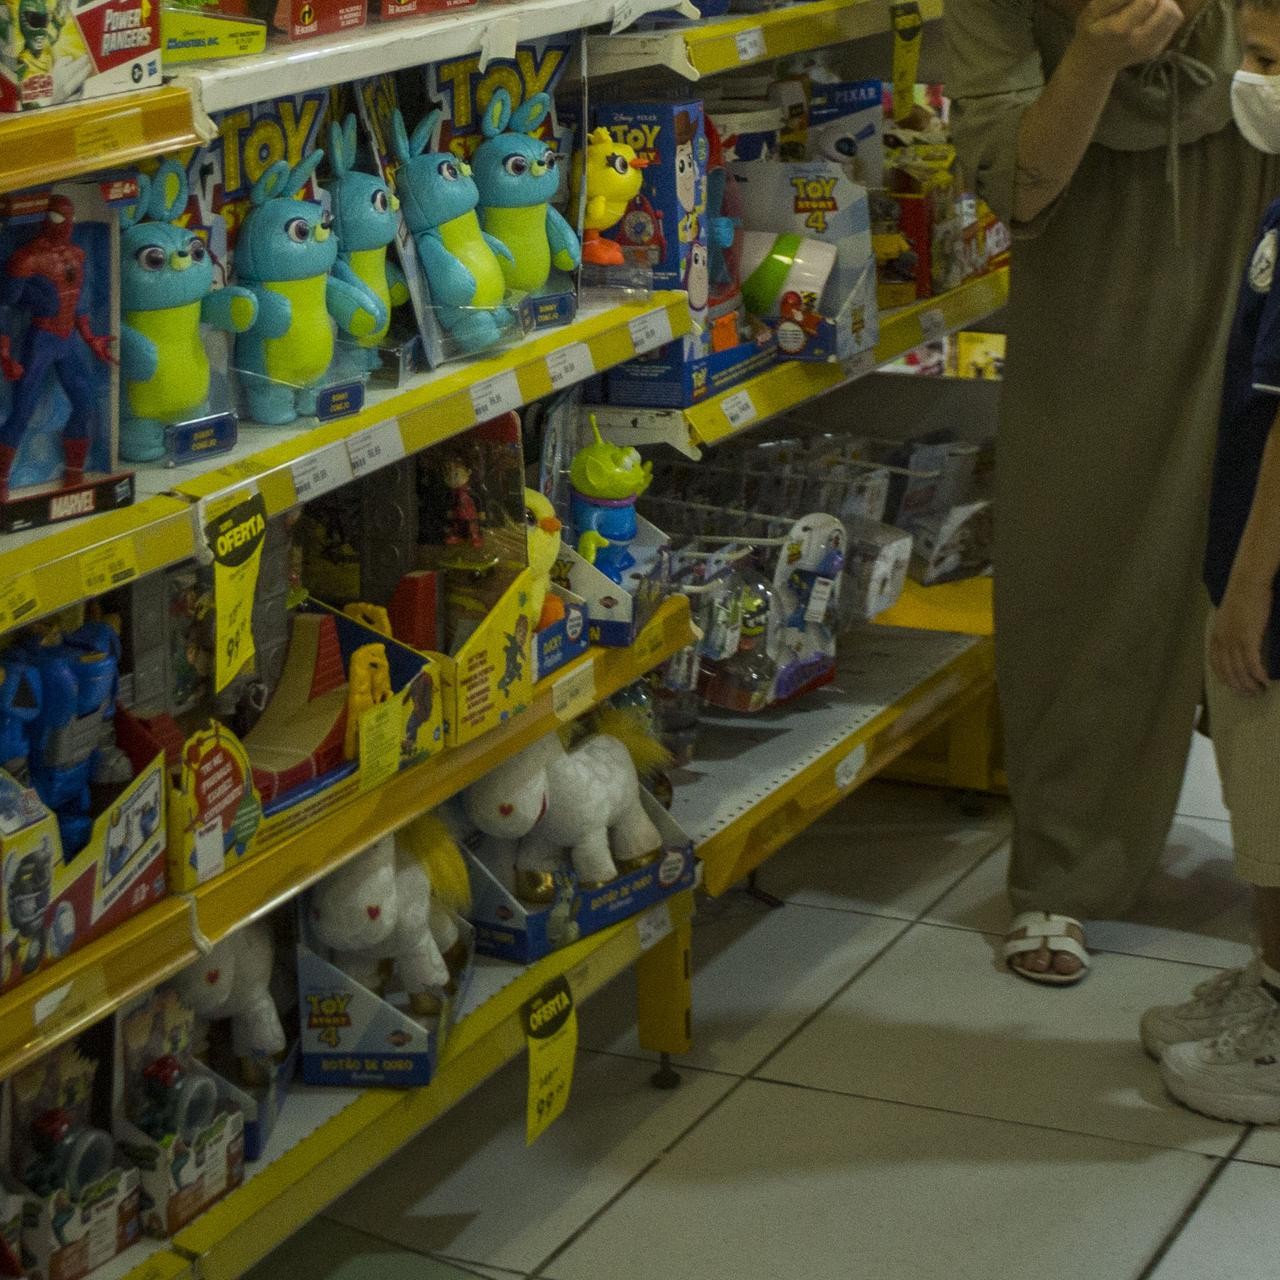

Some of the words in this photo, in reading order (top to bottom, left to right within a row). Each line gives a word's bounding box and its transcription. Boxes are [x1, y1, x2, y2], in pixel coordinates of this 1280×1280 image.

[104, 8, 142, 33] POWER
[101, 26, 153, 57] RANGERS
[439, 49, 564, 128] TOY
[833, 86, 877, 104] PIXAR
[218, 98, 322, 194] TOY
[611, 125, 661, 153] TOY
[790, 176, 838, 200] TOY
[806, 211, 829, 233] 4
[51, 488, 95, 520] MARVEL
[216, 513, 266, 558] OFERTA
[307, 994, 352, 1017] TOY
[528, 991, 571, 1033] OFERTA
[319, 1025, 341, 1048] 4
